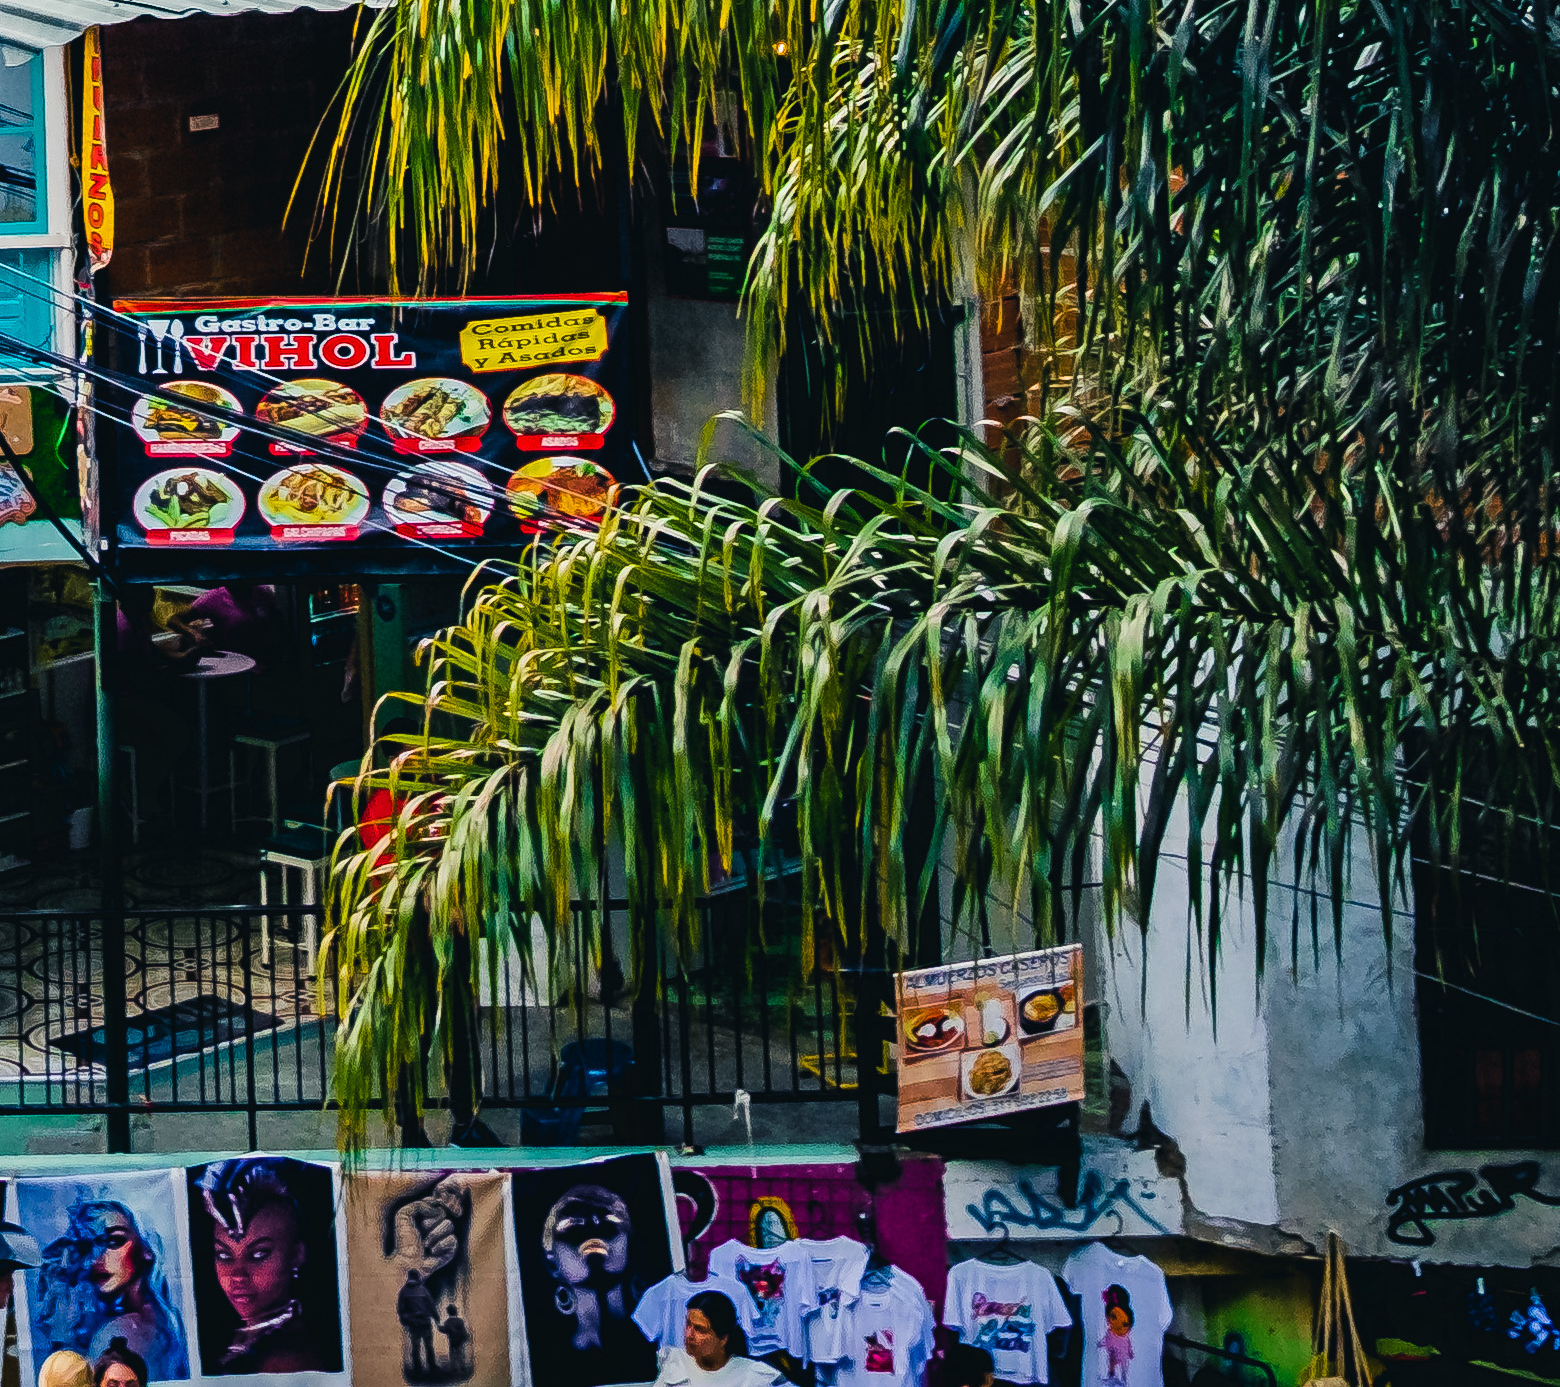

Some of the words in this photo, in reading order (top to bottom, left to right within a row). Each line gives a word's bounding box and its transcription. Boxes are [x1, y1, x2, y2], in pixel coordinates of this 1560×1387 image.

[194, 313, 376, 333] Gastro-Bar
[471, 315, 596, 336] Comidas
[478, 329, 592, 351] Rápidas
[182, 333, 416, 371] VIHOL
[474, 357, 489, 369] y
[498, 345, 597, 365] Asados
